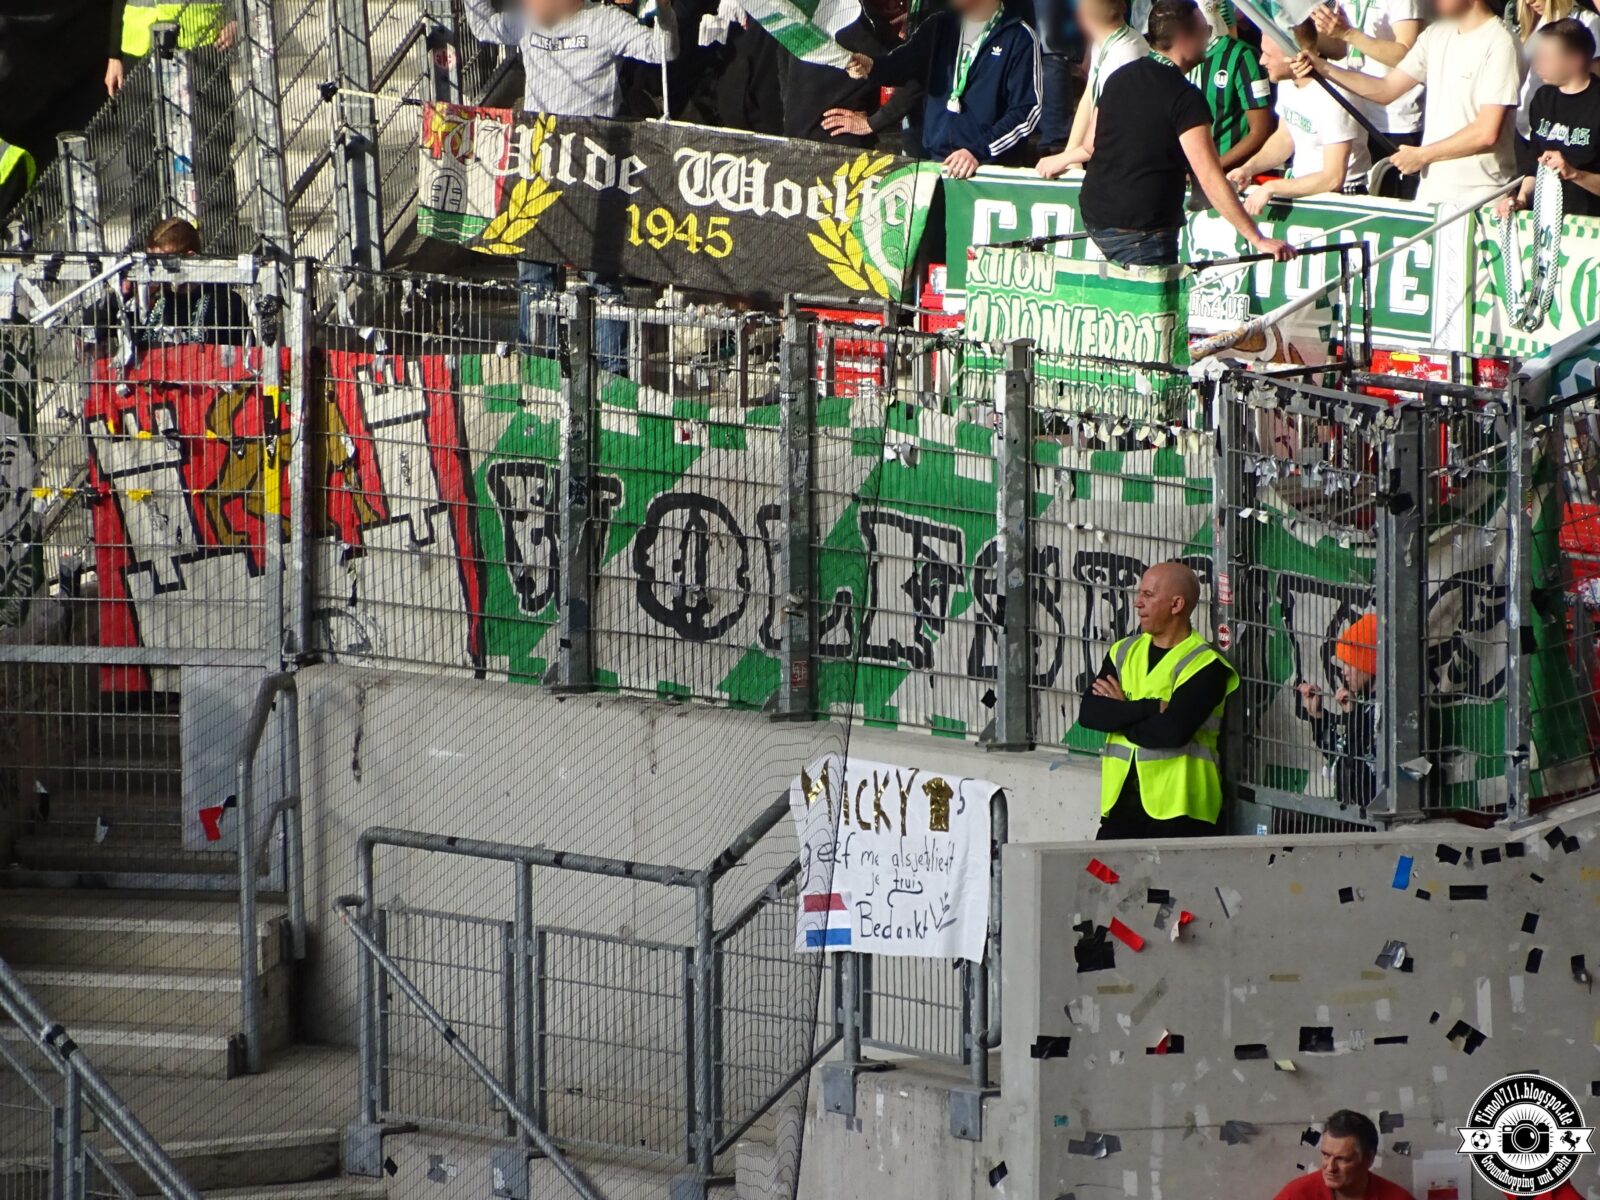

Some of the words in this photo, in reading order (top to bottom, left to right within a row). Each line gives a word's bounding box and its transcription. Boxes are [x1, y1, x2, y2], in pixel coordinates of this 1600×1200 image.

[673, 147, 910, 226] Woelfe
[626, 204, 734, 258] 1945
[861, 850, 880, 866] me
[865, 871, 881, 896] je
[855, 901, 928, 940] Bedankt
